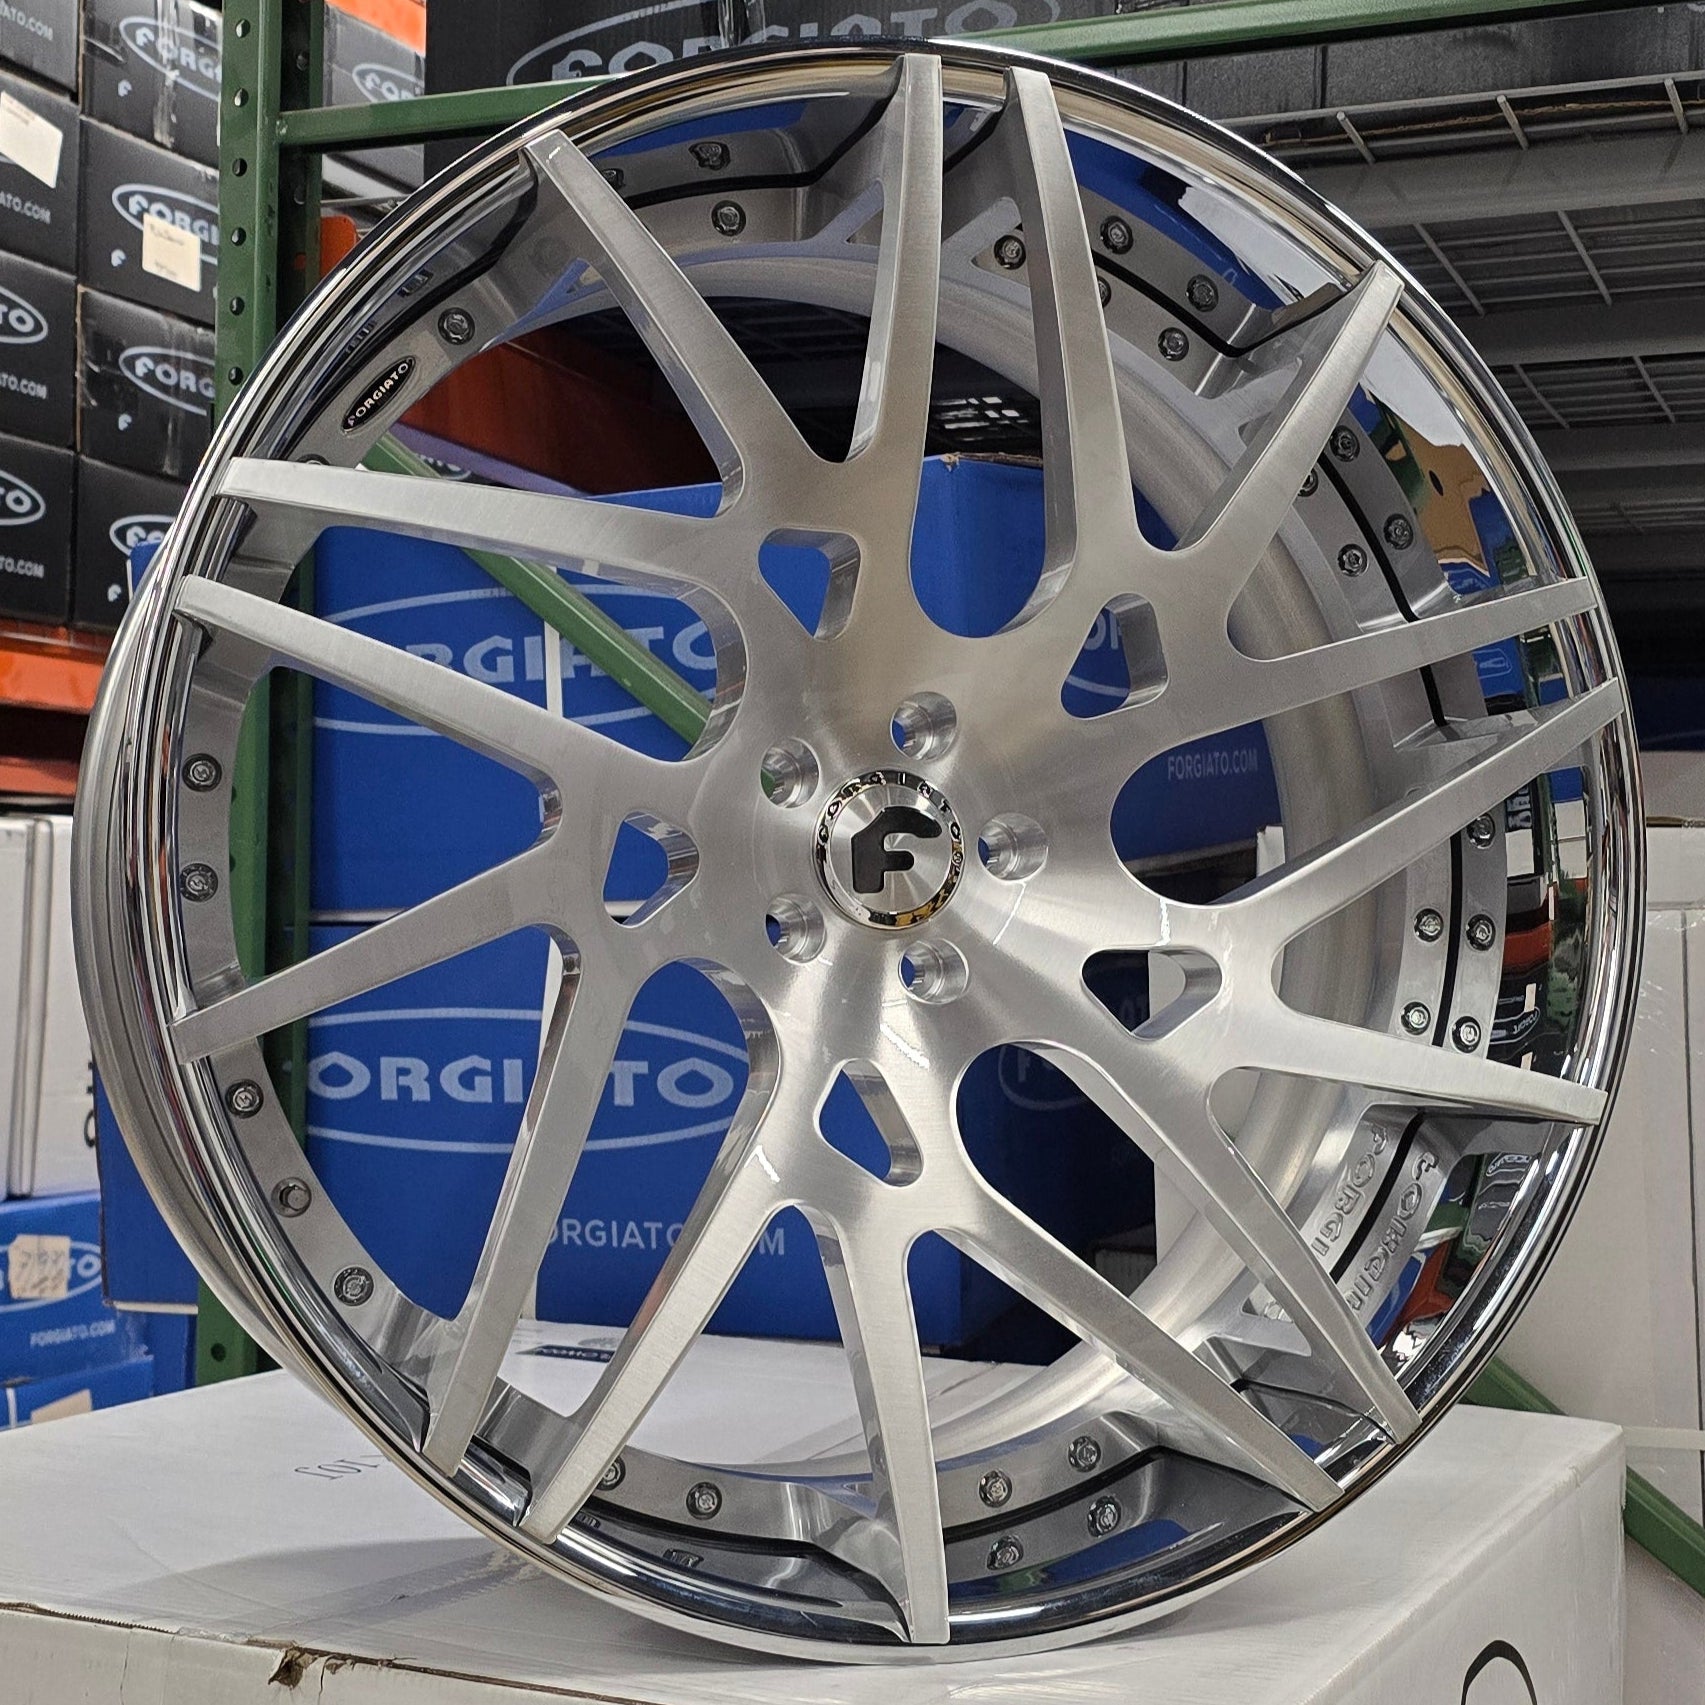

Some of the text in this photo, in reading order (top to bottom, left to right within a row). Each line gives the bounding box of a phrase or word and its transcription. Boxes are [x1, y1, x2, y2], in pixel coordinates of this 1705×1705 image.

[346, 362, 409, 427] FORGIATO
[1168, 748, 1258, 780] FORGIATO.COM
[851, 805, 942, 894] F
